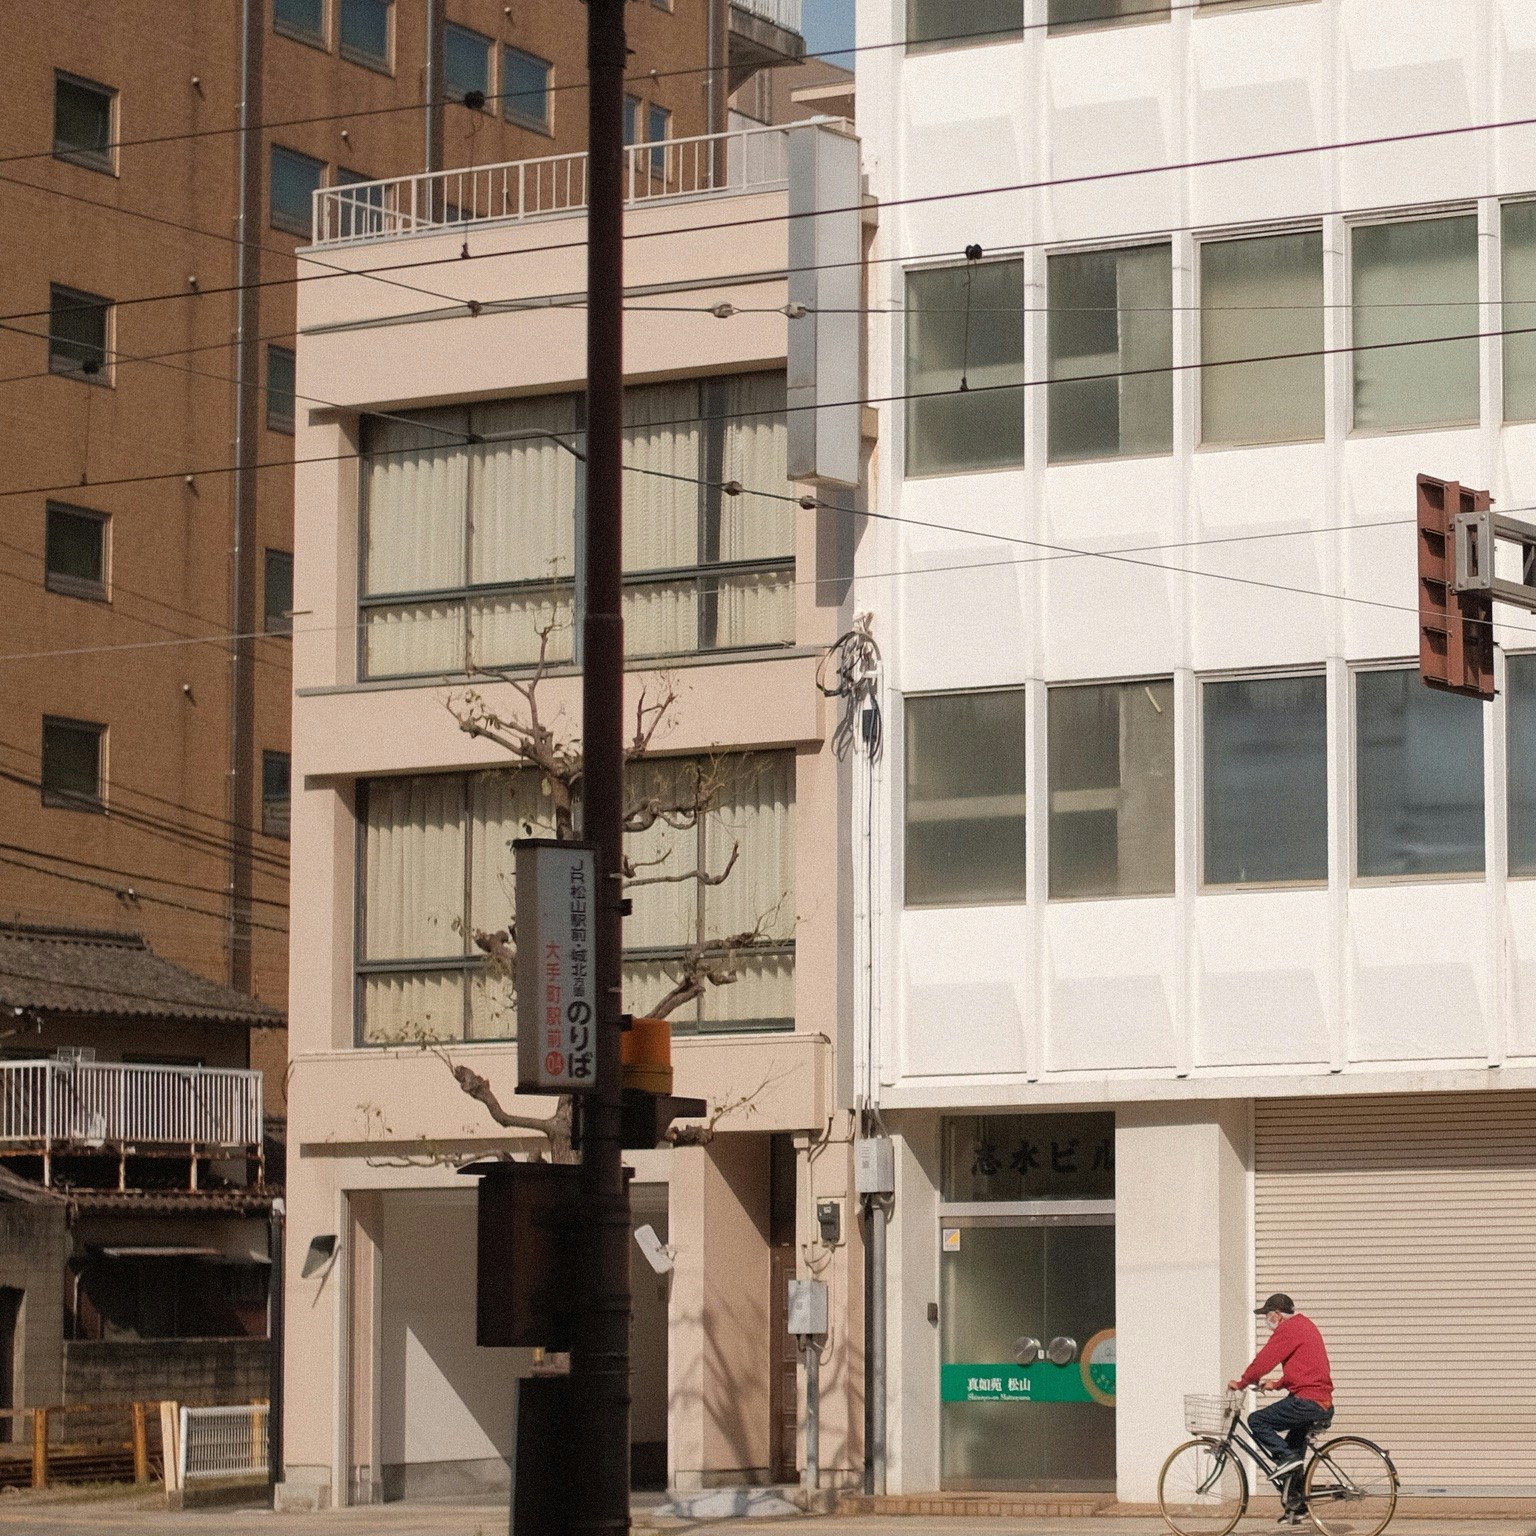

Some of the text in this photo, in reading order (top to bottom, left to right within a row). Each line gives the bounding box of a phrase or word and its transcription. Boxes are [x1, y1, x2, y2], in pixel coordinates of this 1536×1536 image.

[545, 940, 562, 1048] 大手町駅前
[1008, 1377, 1031, 1391] 松山
